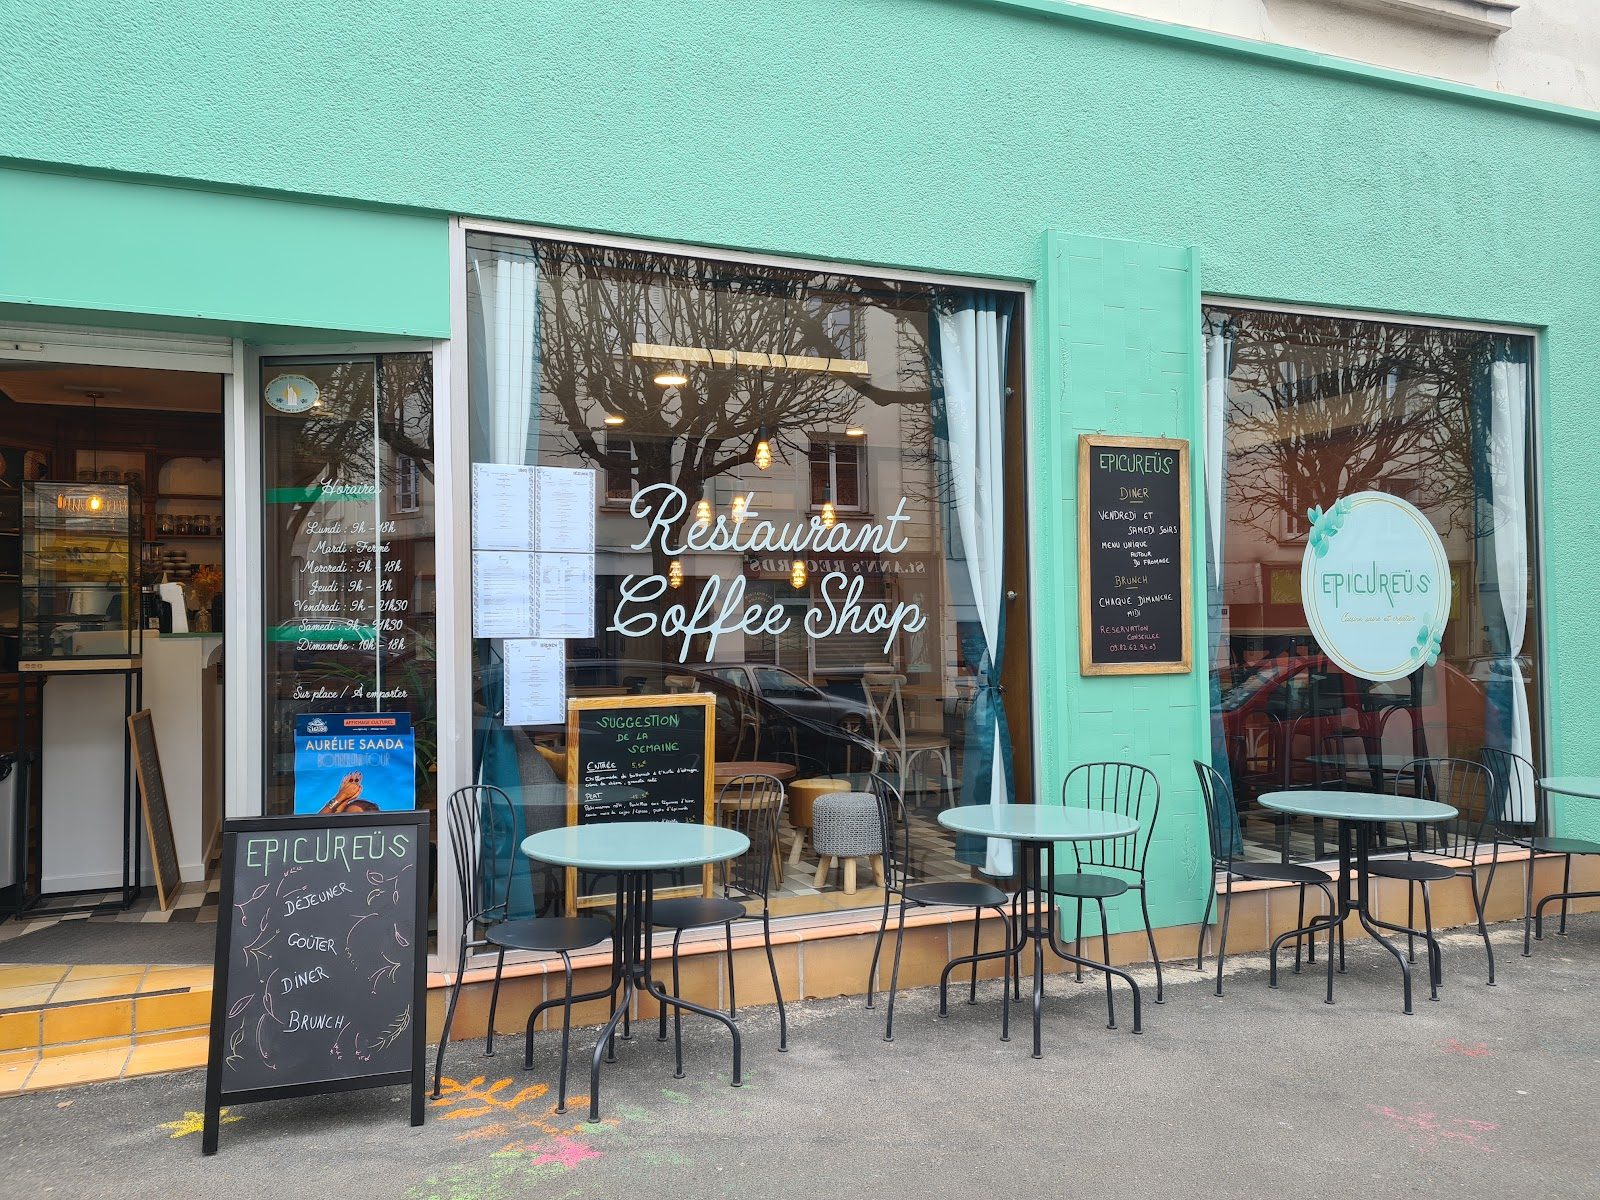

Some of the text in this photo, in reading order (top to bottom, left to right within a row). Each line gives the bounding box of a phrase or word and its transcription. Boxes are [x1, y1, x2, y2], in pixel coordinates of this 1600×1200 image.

[1100, 452, 1173, 475] EPICUREÜS
[629, 482, 912, 556] Restaurant
[1144, 512, 1154, 520] ET
[306, 521, 342, 534] Lundi
[350, 520, 366, 534] 9h
[312, 541, 347, 554] Mardi
[1102, 541, 1120, 549] MENU
[300, 560, 348, 573] Mercredi
[356, 560, 372, 573] 9h
[384, 560, 402, 572] 18h
[309, 580, 338, 595] Jeudi
[348, 580, 363, 592] 9h
[1114, 576, 1148, 588] BRUNCH
[1322, 560, 1432, 608] EPICUREÜS
[294, 600, 340, 612] Vendredi
[350, 599, 366, 611] 9h
[1098, 594, 1173, 608] CHAQUE DIMANCHE
[606, 574, 791, 663] Coffee
[804, 572, 926, 654] Shop
[1127, 608, 1140, 618] MIDI
[298, 619, 336, 632] Samedi
[297, 638, 348, 651] Dimanche
[387, 638, 405, 650] 18h
[292, 686, 310, 700] Sur
[312, 686, 338, 702] place
[366, 687, 408, 702] emporter
[596, 714, 680, 728] SUGGESTION
[306, 736, 404, 750] AURÉLIE SAADA
[616, 734, 629, 742] DE
[628, 742, 680, 754] SEMAINE
[246, 828, 409, 876] EPICUREÜS
[283, 882, 352, 917] DÉJEUNER
[288, 932, 337, 956] GOÛTER
[282, 1010, 344, 1033] BRUNCH
